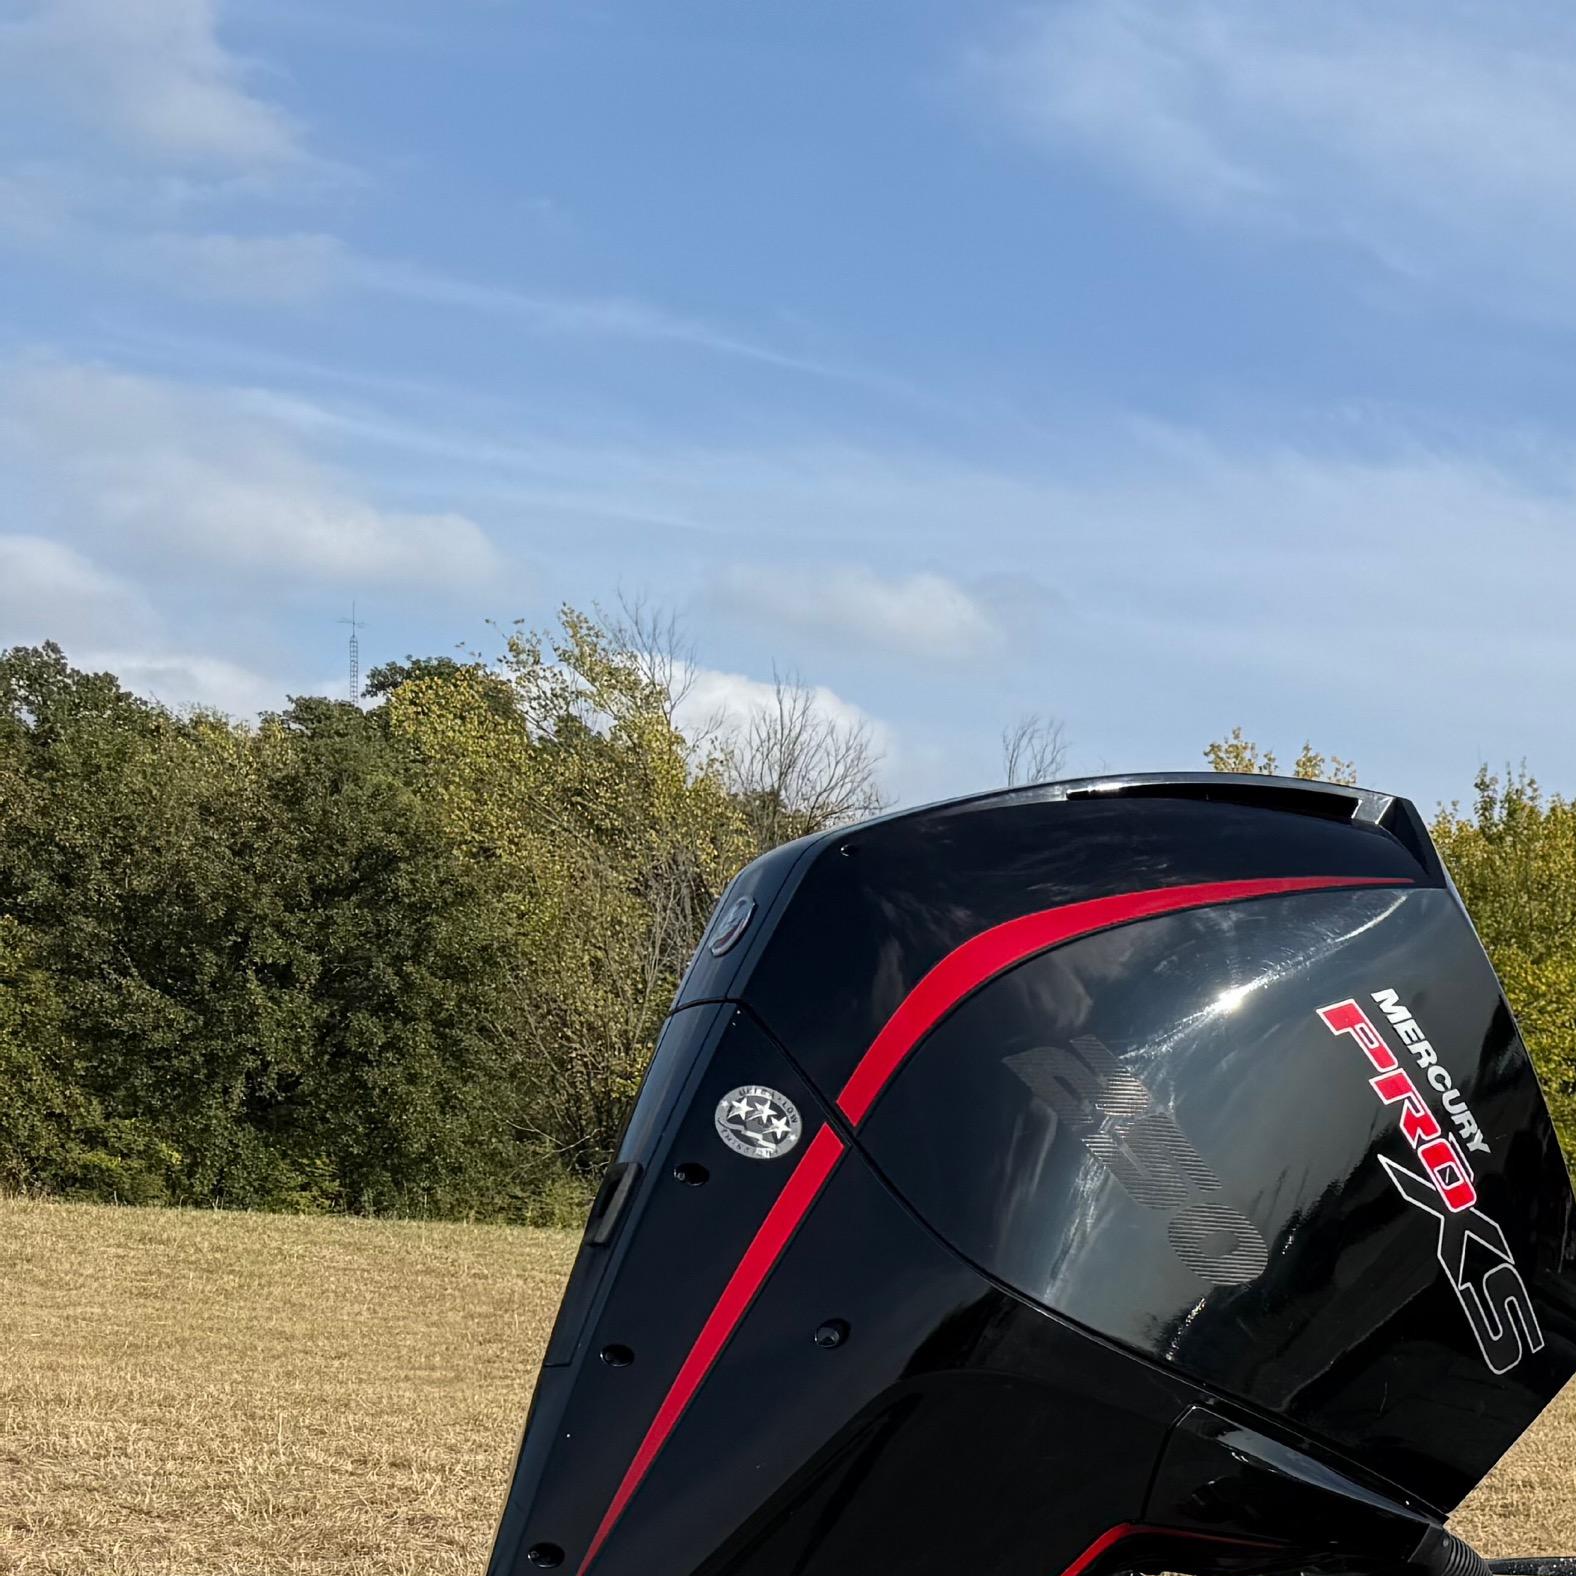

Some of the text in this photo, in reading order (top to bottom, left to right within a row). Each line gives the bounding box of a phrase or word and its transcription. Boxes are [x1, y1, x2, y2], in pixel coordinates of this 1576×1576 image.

[1316, 998, 1545, 1375] PRO XS
[1371, 988, 1491, 1154] MERCURY
